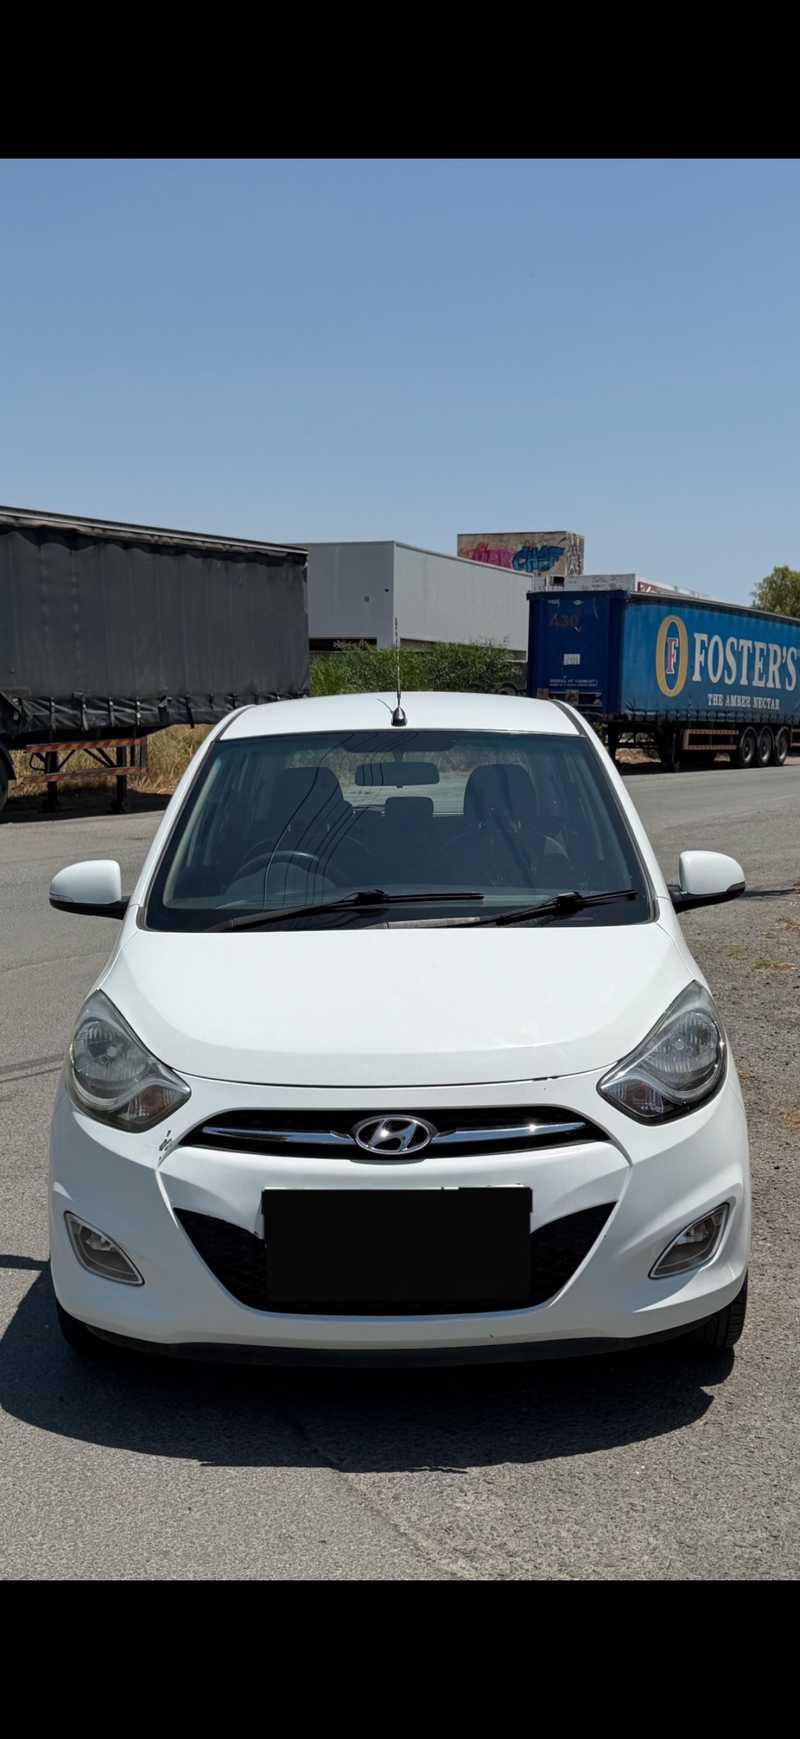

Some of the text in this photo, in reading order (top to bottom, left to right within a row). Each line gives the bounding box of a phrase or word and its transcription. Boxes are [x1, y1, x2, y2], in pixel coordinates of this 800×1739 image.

[666, 637, 679, 674] F
[691, 632, 798, 691] FOSTER'S
[707, 693, 780, 710] THE AMBER NECTAR
